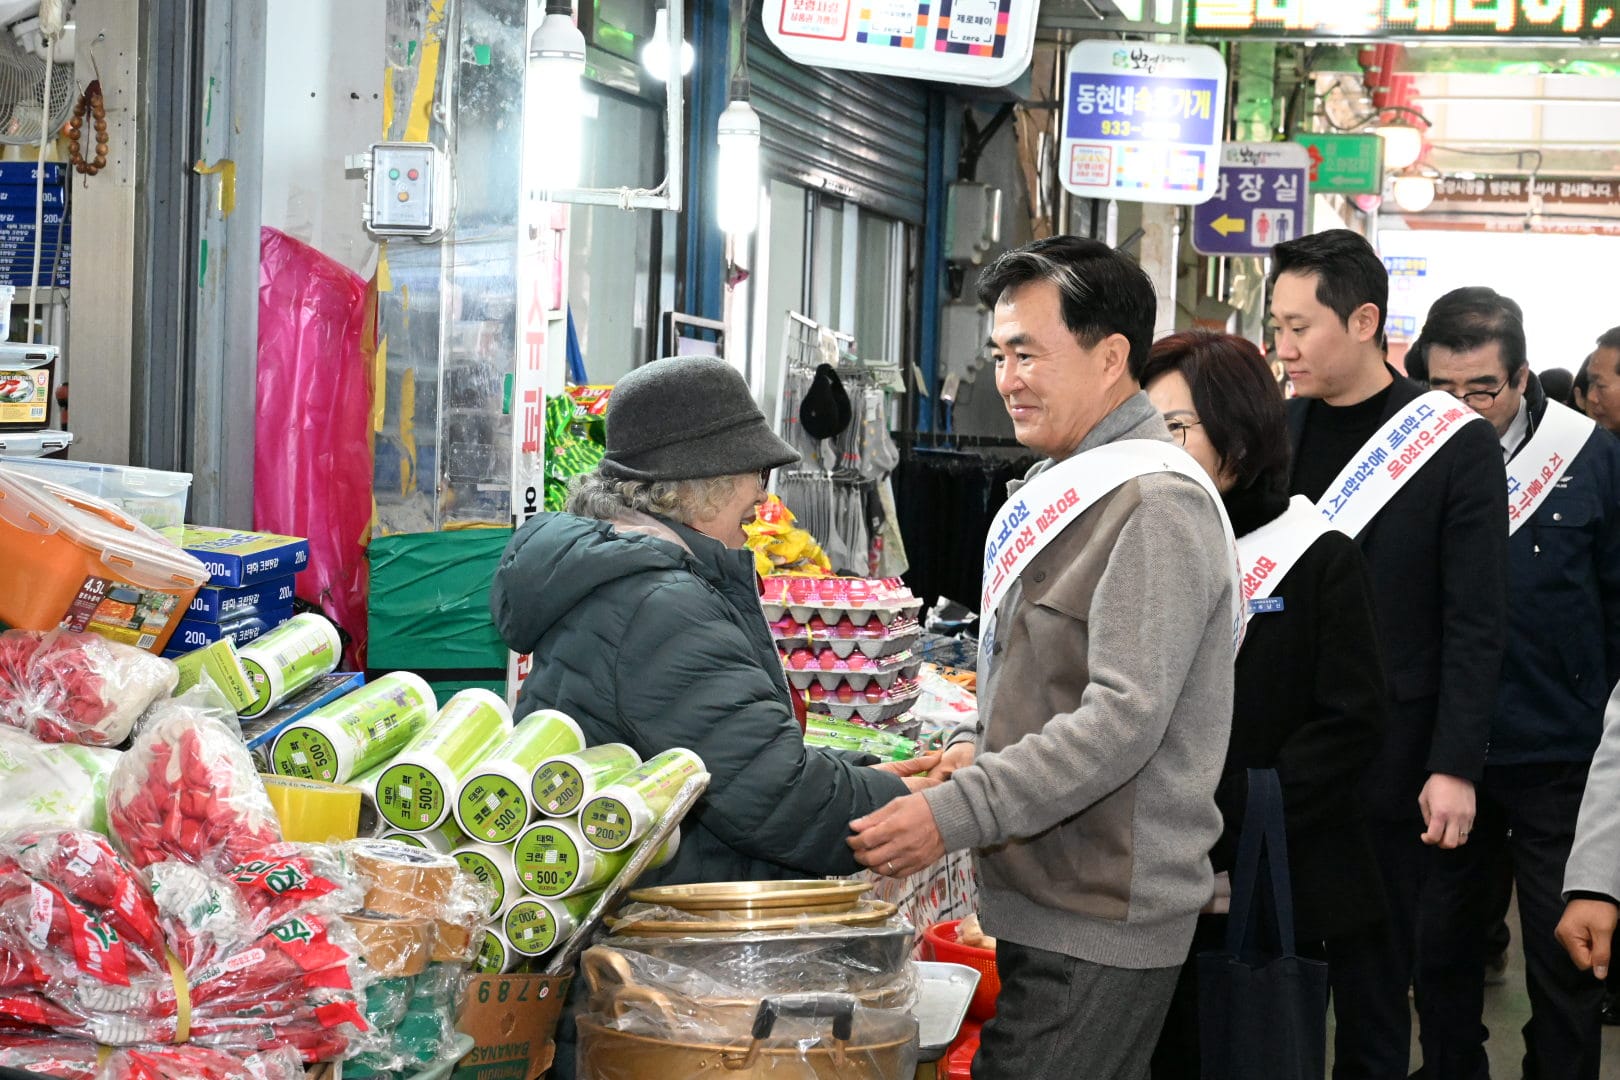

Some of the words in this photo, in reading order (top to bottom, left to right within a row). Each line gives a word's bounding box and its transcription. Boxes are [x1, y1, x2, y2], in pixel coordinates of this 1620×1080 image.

[956, 13, 993, 26] 제로페이
[1076, 83, 1212, 120] 동현네속가게
[1100, 120, 1181, 139] 933-
[83, 578, 105, 594] 4.3L
[309, 743, 328, 768] 500
[419, 787, 433, 810] 500
[555, 787, 575, 806] 200
[494, 808, 517, 831] 500
[595, 827, 615, 840] 200
[473, 865, 488, 882] 00
[536, 870, 558, 885] 500
[478, 980, 491, 1004] 9
[497, 980, 511, 1003] 8
[471, 1040, 531, 1064] BANANAS
